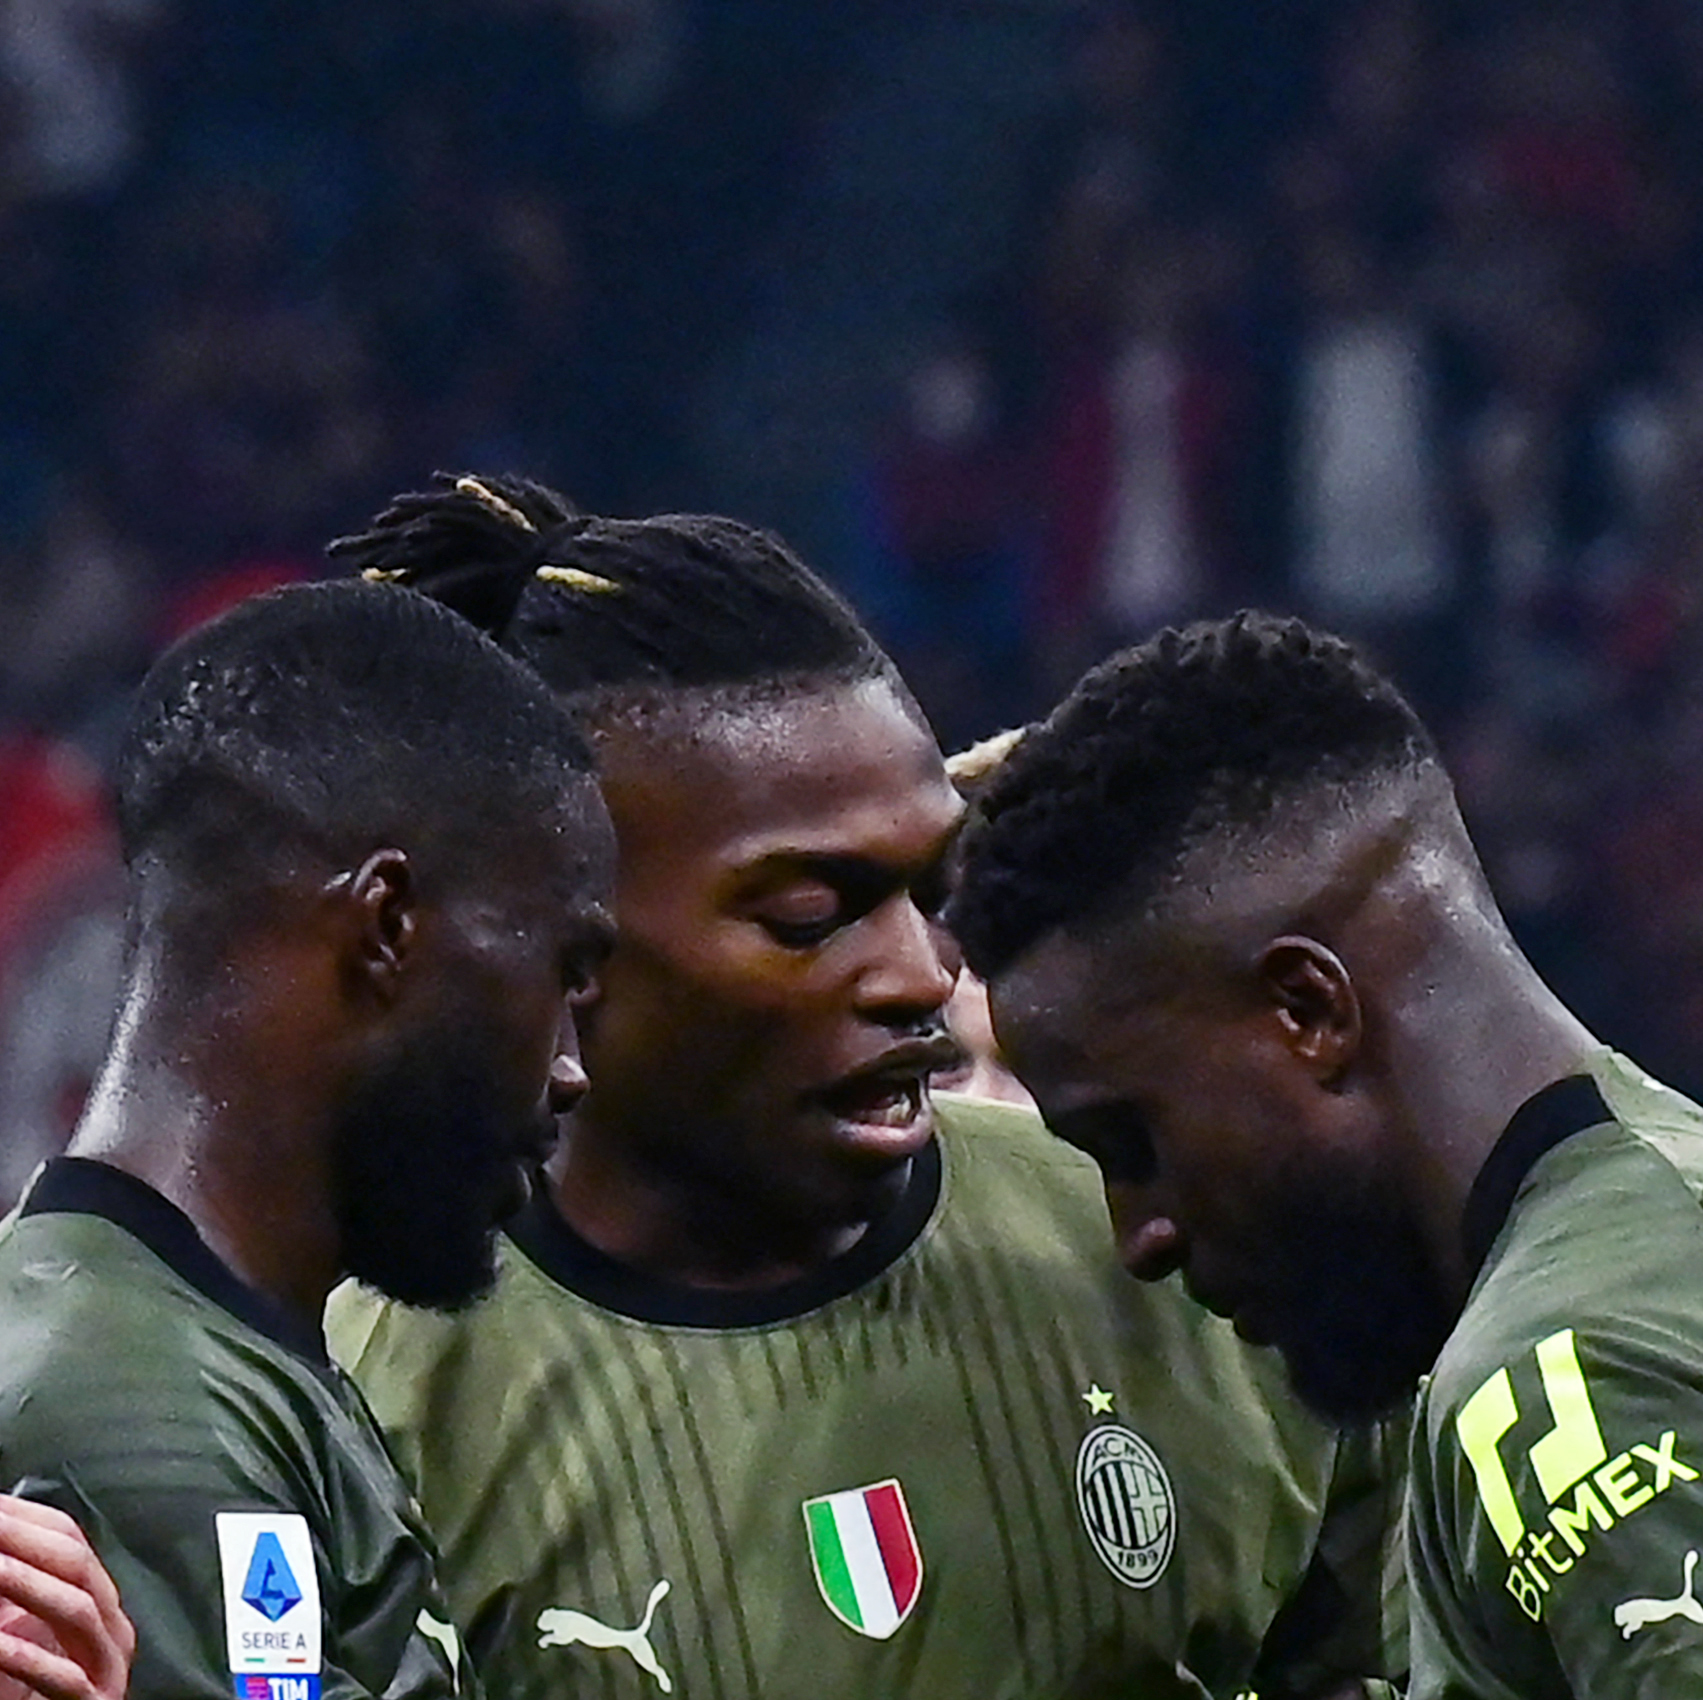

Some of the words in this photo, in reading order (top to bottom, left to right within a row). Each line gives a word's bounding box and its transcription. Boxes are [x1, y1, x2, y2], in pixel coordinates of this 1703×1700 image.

[1505, 1430, 1700, 1622] BitMEX
[1118, 1551, 1159, 1569] 1899
[242, 1632, 290, 1650] SERIE
[295, 1632, 307, 1650] A
